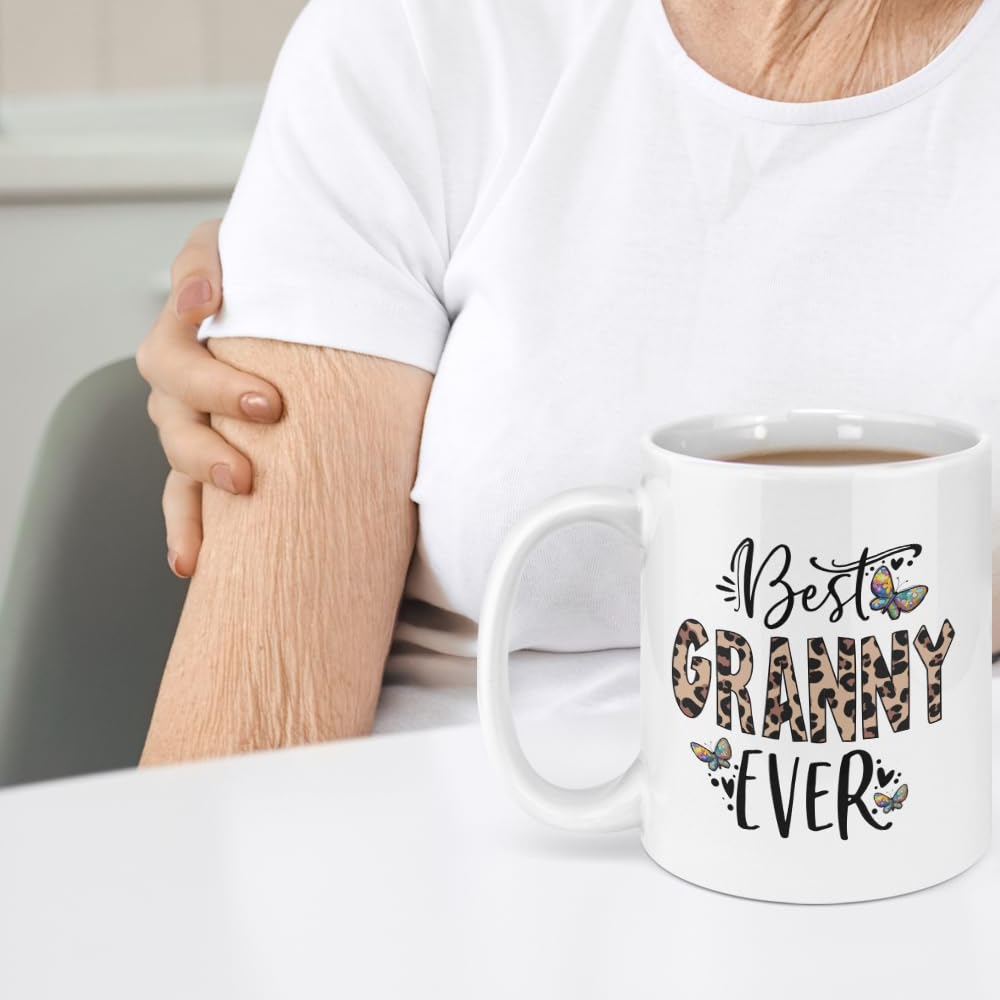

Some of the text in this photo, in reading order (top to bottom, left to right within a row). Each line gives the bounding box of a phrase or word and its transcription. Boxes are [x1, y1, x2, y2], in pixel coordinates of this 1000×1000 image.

[731, 537, 922, 629] Best
[672, 618, 955, 743] GRANNY
[736, 749, 893, 841] EVER
